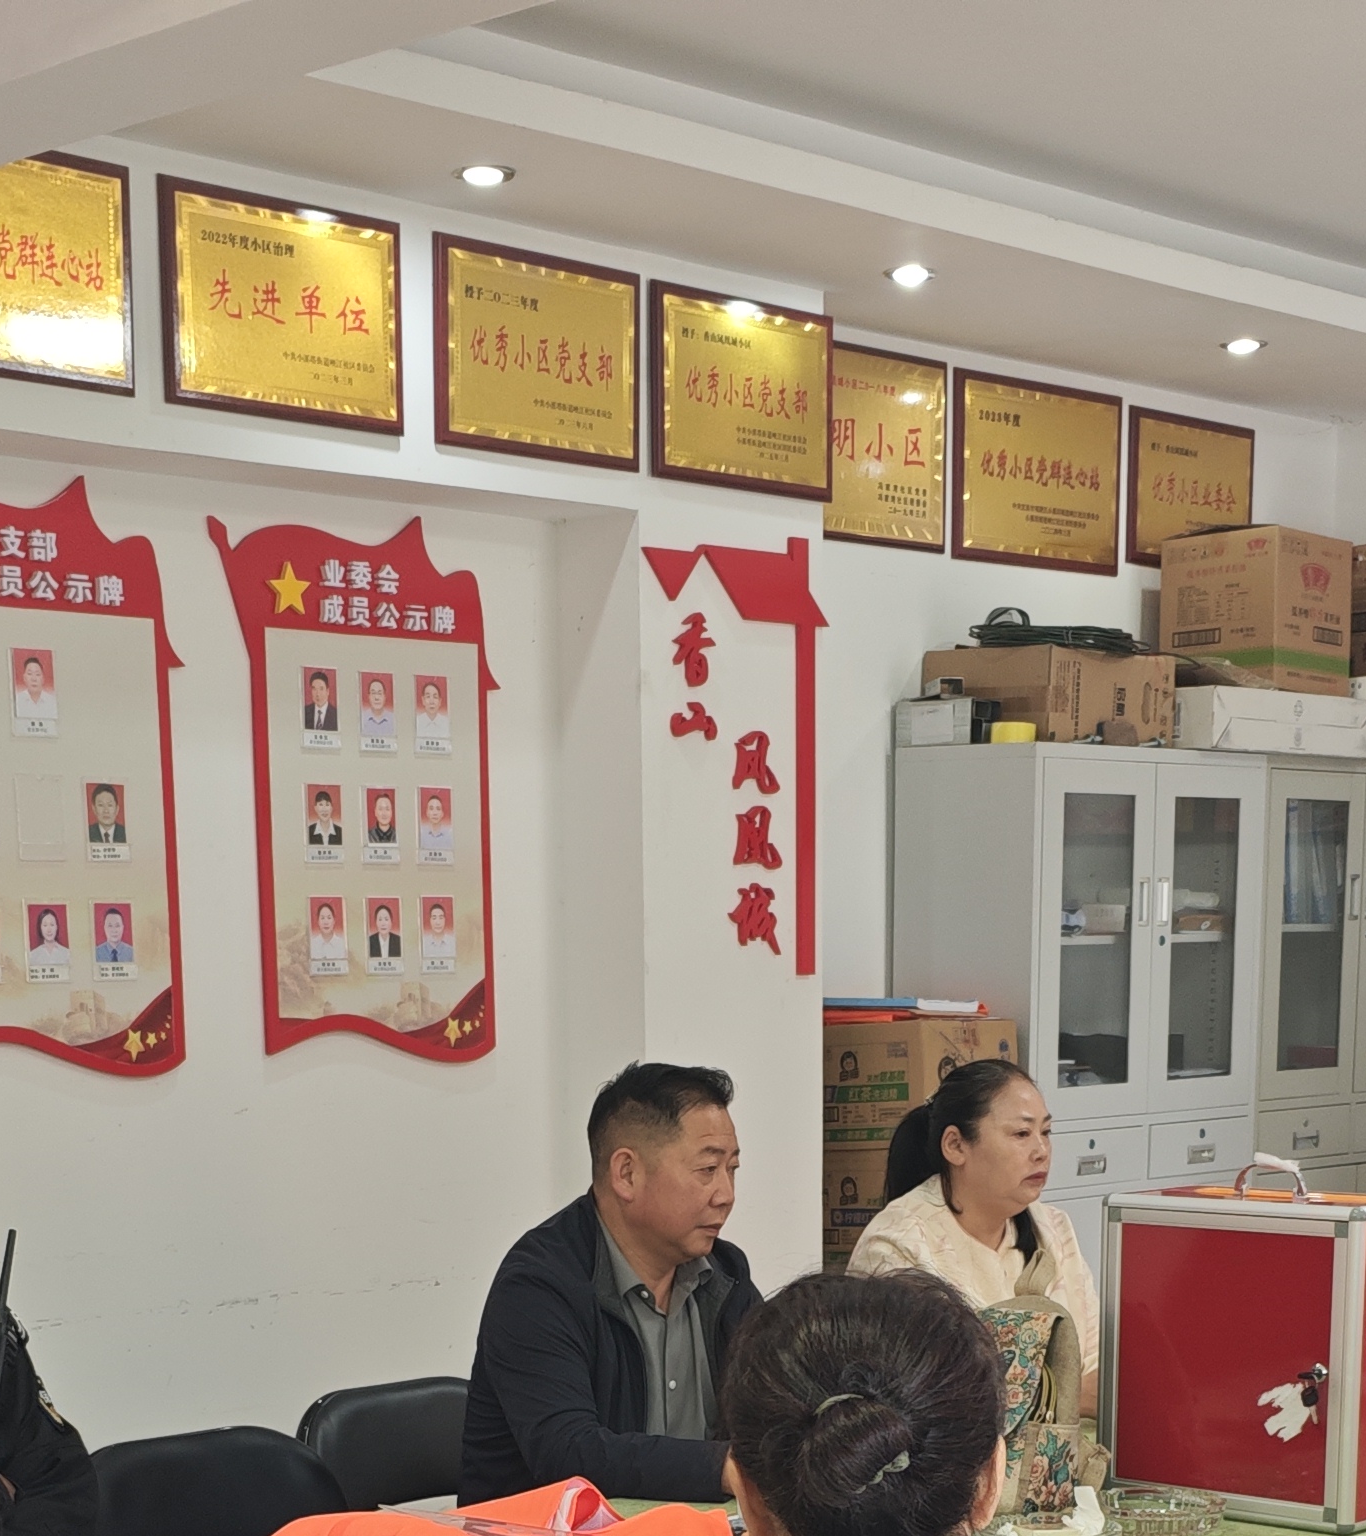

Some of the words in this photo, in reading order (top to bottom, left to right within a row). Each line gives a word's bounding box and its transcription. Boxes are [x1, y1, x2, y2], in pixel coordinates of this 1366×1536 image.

[201, 229, 295, 258] 2022年度小区治理
[208, 269, 370, 335] 先进单位
[470, 325, 612, 391] 优秀小区党支部
[685, 365, 808, 424] 优秀小区党支部
[981, 449, 1101, 491] 优秀小区党群连心站
[319, 559, 400, 595] 业委会
[319, 594, 456, 634] 成员公示牌
[670, 611, 717, 742] 香山
[727, 730, 782, 956] 凤凰城
